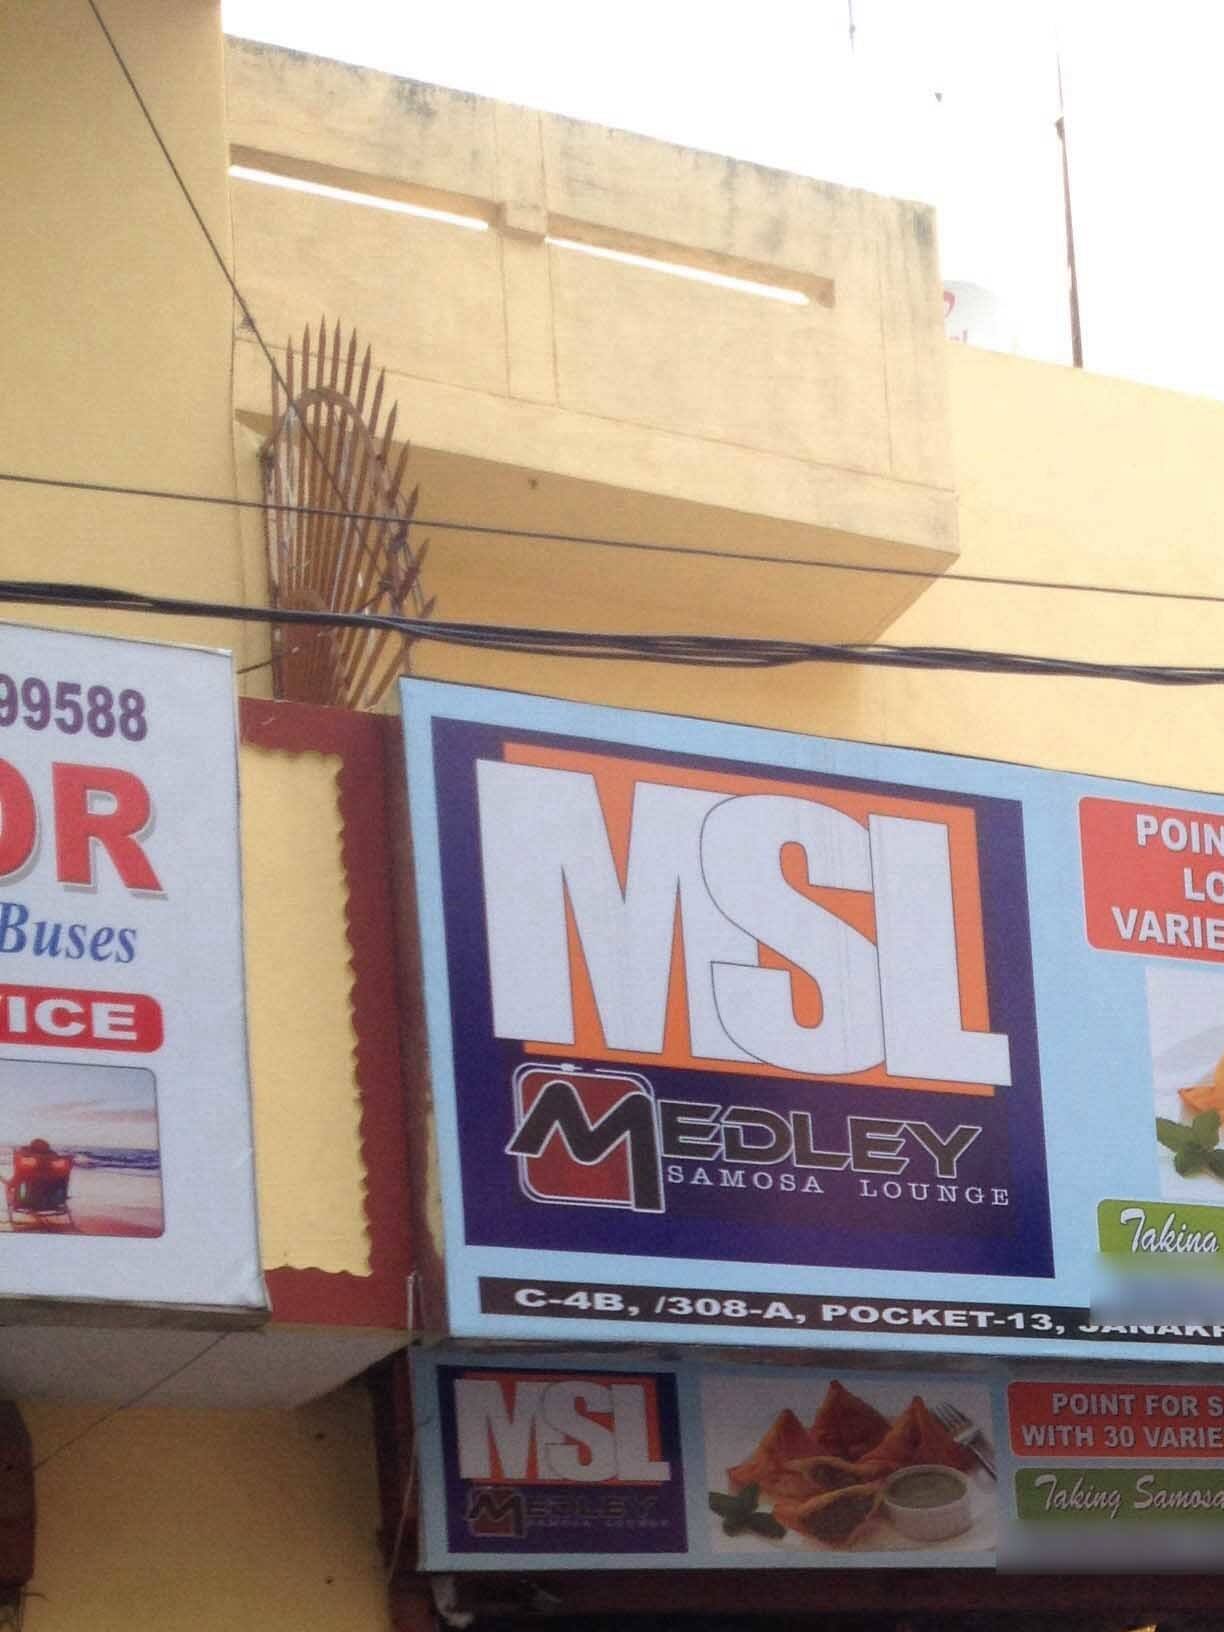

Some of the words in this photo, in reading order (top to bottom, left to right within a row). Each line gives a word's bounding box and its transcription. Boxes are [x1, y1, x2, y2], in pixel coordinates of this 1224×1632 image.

[0, 673, 148, 742] 99588
[0, 903, 138, 963] Buses
[476, 759, 1012, 1088] MSL
[0, 995, 138, 1041] ICE
[505, 1077, 983, 1213] MEDLEY
[666, 1164, 825, 1195] SAMOSA
[859, 1178, 1010, 1207] LOUNGE
[821, 1303, 1064, 1334] POCKET-13,
[1052, 1392, 1137, 1417] POINT
[1146, 1394, 1198, 1417] FOR
[453, 1378, 672, 1483] MSL
[1021, 1425, 1094, 1448] WITH
[1104, 1427, 1135, 1448] 30
[1034, 1474, 1122, 1519] Taking
